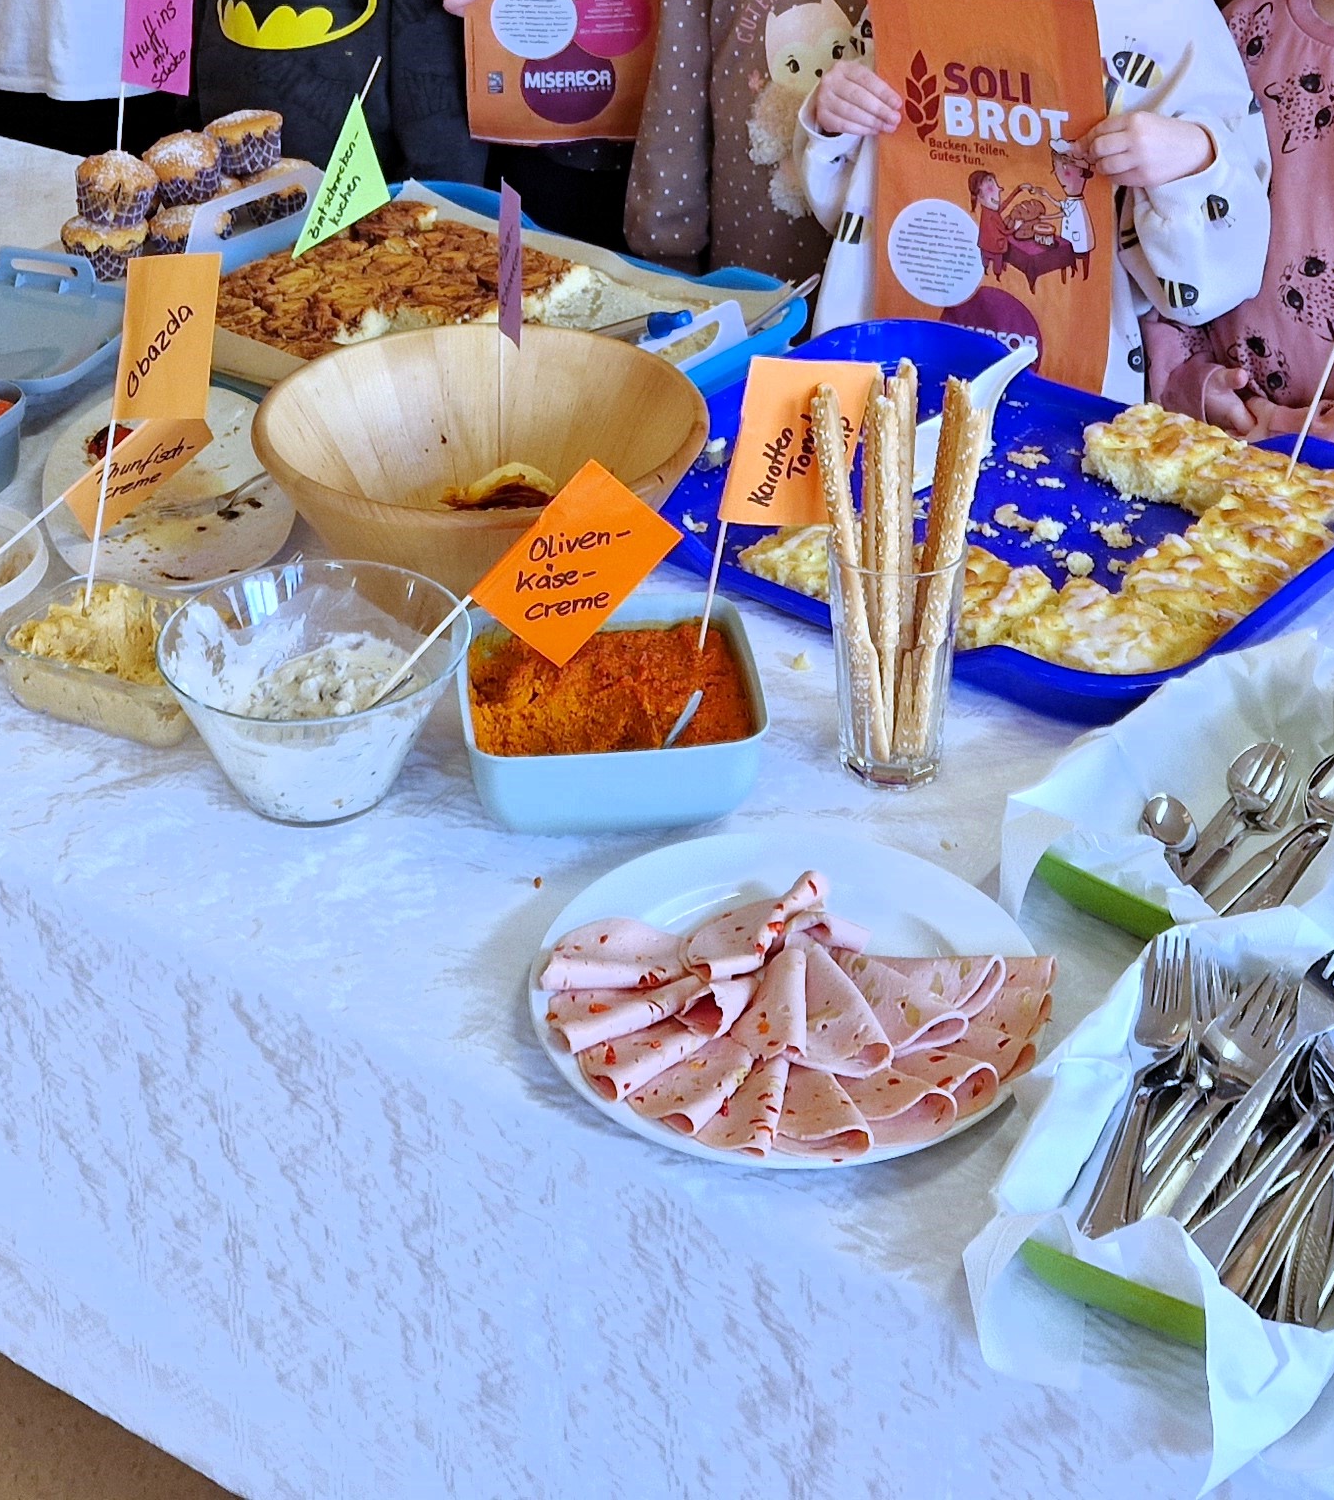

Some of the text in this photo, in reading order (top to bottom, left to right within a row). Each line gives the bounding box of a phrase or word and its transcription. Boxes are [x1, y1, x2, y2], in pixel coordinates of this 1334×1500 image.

[524, 69, 612, 89] MISEREOR
[943, 62, 1032, 105] SOLI
[944, 95, 1069, 148] BROT
[929, 137, 1009, 158] Backen. Teilen.
[929, 149, 985, 167] Gutes tun.
[126, 304, 194, 398] Obazda
[529, 529, 631, 562] Oliven-
[524, 591, 610, 621] creme
